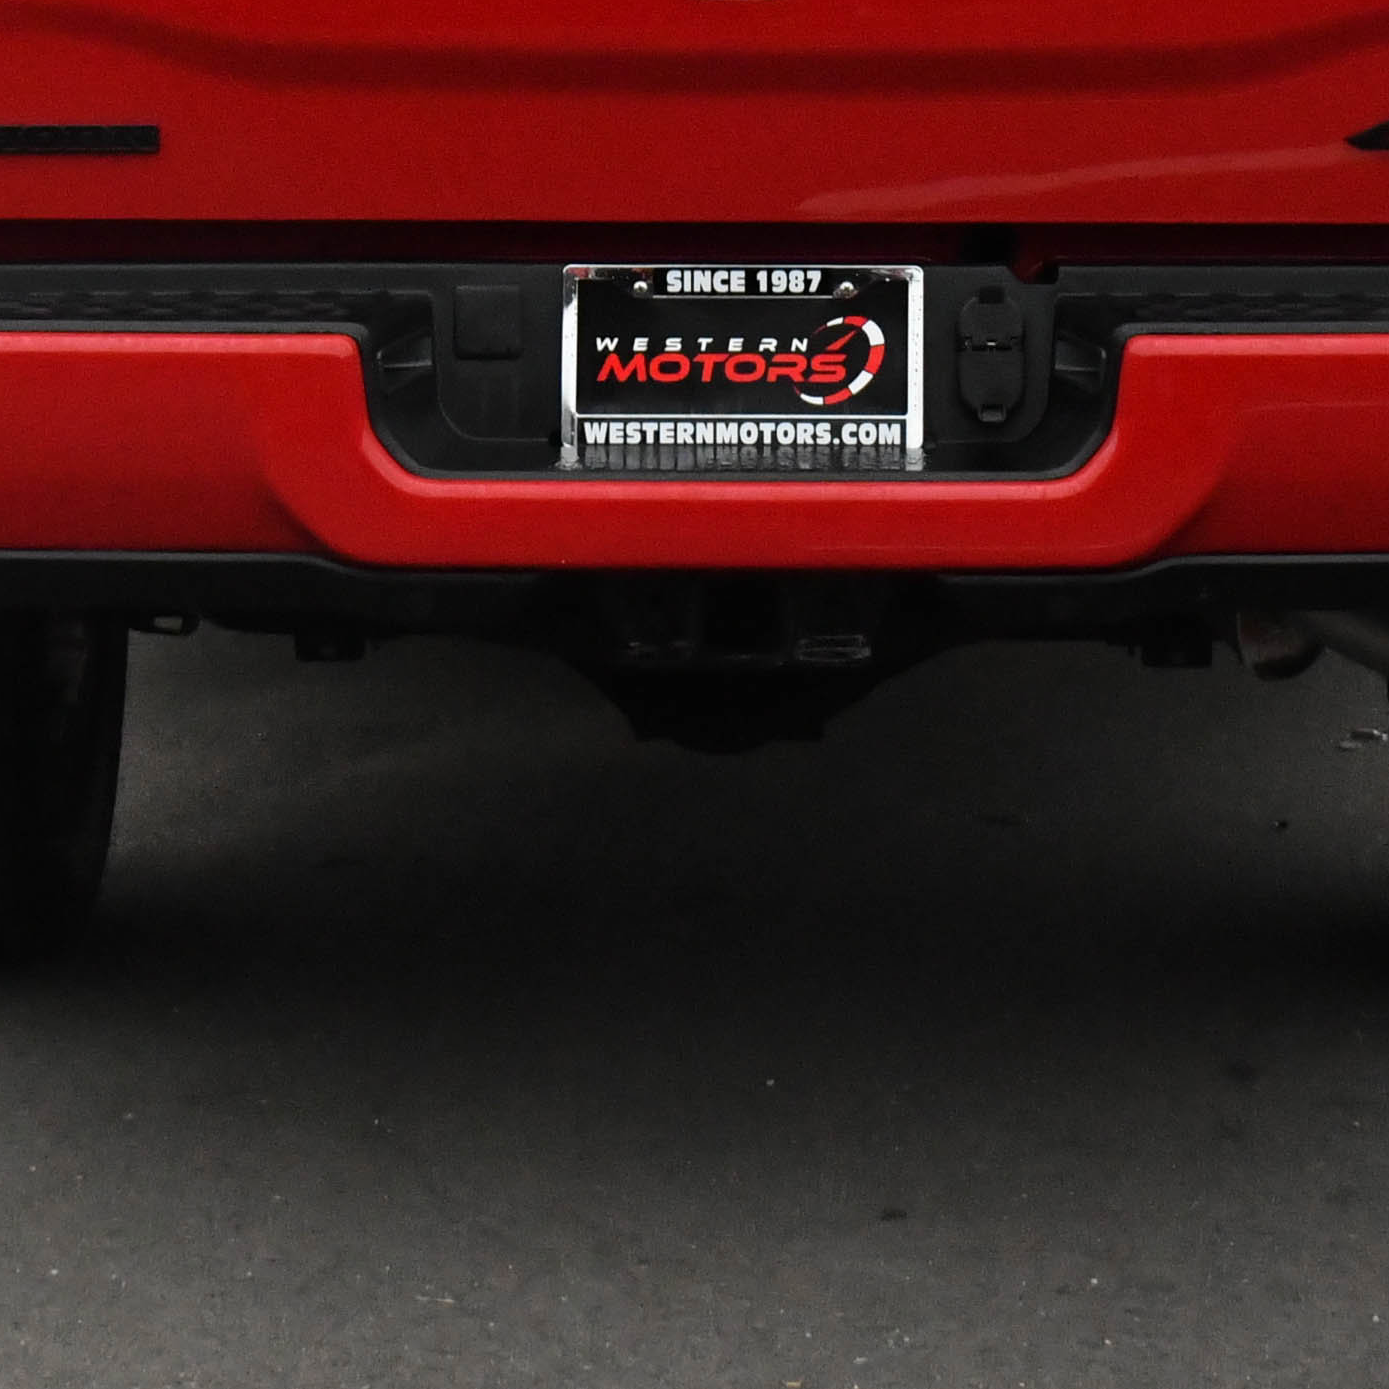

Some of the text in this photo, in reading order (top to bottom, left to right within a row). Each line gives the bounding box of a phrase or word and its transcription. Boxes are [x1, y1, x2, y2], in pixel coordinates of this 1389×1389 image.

[666, 270, 822, 293] SINCE 1987
[595, 337, 808, 352] WESTERN
[596, 353, 848, 383] MOTORS
[583, 421, 902, 446] WESTERNMOTORS.COM
